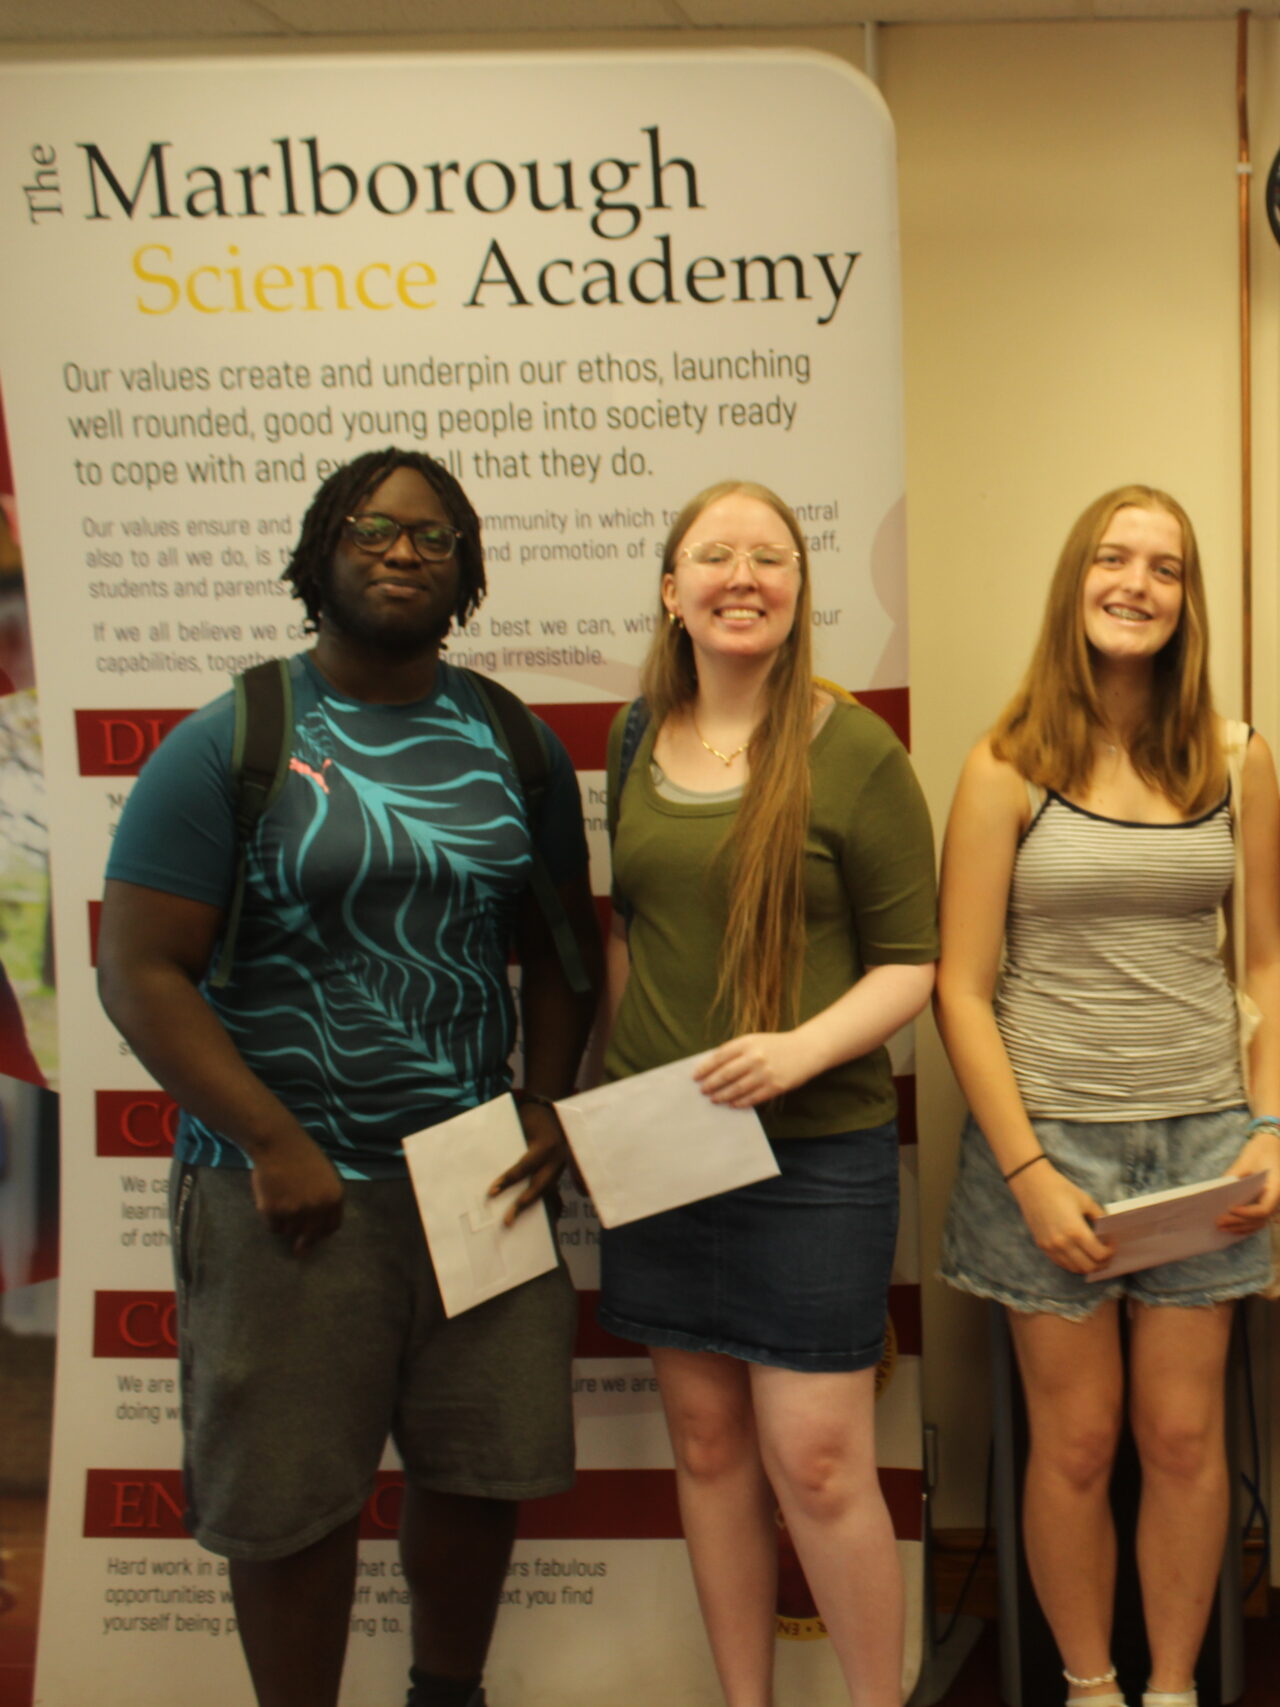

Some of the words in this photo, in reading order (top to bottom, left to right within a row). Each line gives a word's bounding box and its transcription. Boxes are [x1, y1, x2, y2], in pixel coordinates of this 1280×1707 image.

[22, 142, 64, 225] The
[75, 125, 706, 239] Marlborough
[132, 244, 438, 315] Science
[463, 234, 862, 326] Academy
[63, 361, 111, 393] Our
[119, 360, 211, 392] values
[219, 362, 311, 391] create
[320, 358, 373, 389] and
[383, 355, 509, 391] underpin
[519, 359, 567, 385] our
[577, 353, 664, 387] ethos,
[673, 349, 812, 384] launching
[68, 408, 124, 439] well
[132, 406, 256, 440] rounded,
[264, 406, 333, 442] good
[341, 408, 428, 442] young
[437, 402, 533, 438] people
[542, 401, 597, 431] into
[606, 399, 708, 434] society
[717, 395, 797, 432] ready
[74, 457, 103, 486] to
[111, 460, 179, 490] cope
[186, 454, 246, 485] with
[255, 451, 307, 483] and
[473, 449, 531, 479] that
[541, 447, 601, 484] they
[612, 446, 654, 478] do.
[82, 517, 114, 539] Our
[120, 516, 180, 538] values
[187, 518, 249, 538] ensure
[257, 514, 293, 535] and
[575, 509, 593, 530] in
[598, 508, 653, 529] which
[795, 500, 840, 521] ntral
[86, 548, 123, 569] also
[131, 550, 149, 568] to
[157, 547, 179, 567] all
[187, 550, 213, 567] we
[221, 547, 248, 569] do,
[256, 546, 271, 566] is
[520, 540, 620, 565] promotion
[627, 540, 645, 559] of
[89, 578, 168, 599] students
[174, 577, 208, 598] and
[93, 622, 106, 642] If
[113, 625, 141, 642] we
[149, 622, 170, 642] all
[178, 621, 242, 642] believe
[250, 623, 277, 641] we
[490, 617, 532, 637] best
[540, 620, 567, 635] we
[577, 618, 615, 637] can,
[96, 653, 202, 676] capabilities,
[503, 646, 607, 668] irresistible.
[120, 1174, 147, 1194] We
[121, 1228, 138, 1247] of
[117, 1374, 143, 1393] We
[147, 1377, 175, 1394] are
[601, 1377, 627, 1393] we
[116, 1402, 161, 1424] doing
[108, 1556, 146, 1576] Hard
[152, 1557, 193, 1576] work
[198, 1556, 212, 1576] in
[534, 1558, 606, 1578] fabulous
[105, 1585, 216, 1607] opportunities
[526, 1590, 556, 1609] you
[561, 1585, 595, 1606] find
[103, 1612, 169, 1635] yourself
[175, 1613, 220, 1636] being
[382, 1616, 402, 1634] to.
